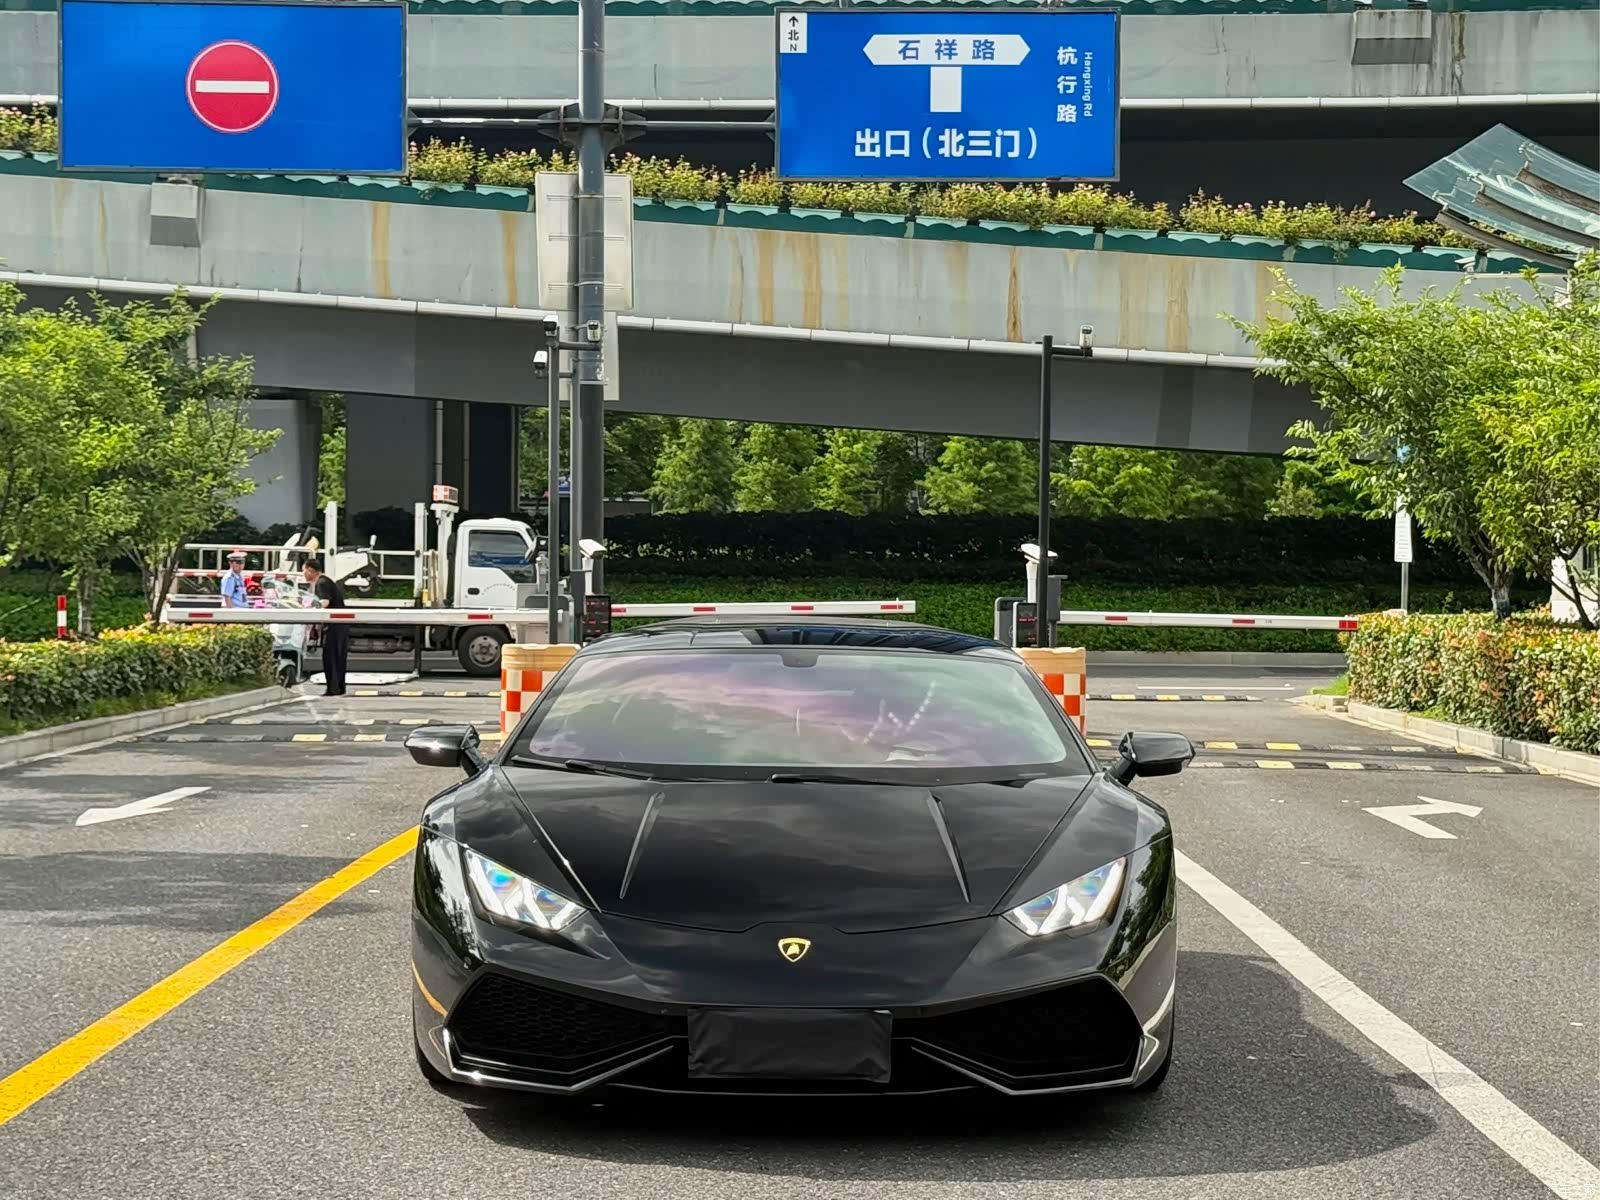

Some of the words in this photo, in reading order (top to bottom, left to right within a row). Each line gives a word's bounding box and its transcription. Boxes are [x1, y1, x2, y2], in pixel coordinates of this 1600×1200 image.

[788, 29, 799, 41] 北
[790, 43, 797, 51] N
[898, 38, 996, 61] 石祥路
[1057, 46, 1078, 123] 杭行路
[1082, 52, 1093, 101] Hangxing
[1083, 103, 1093, 117] Rd
